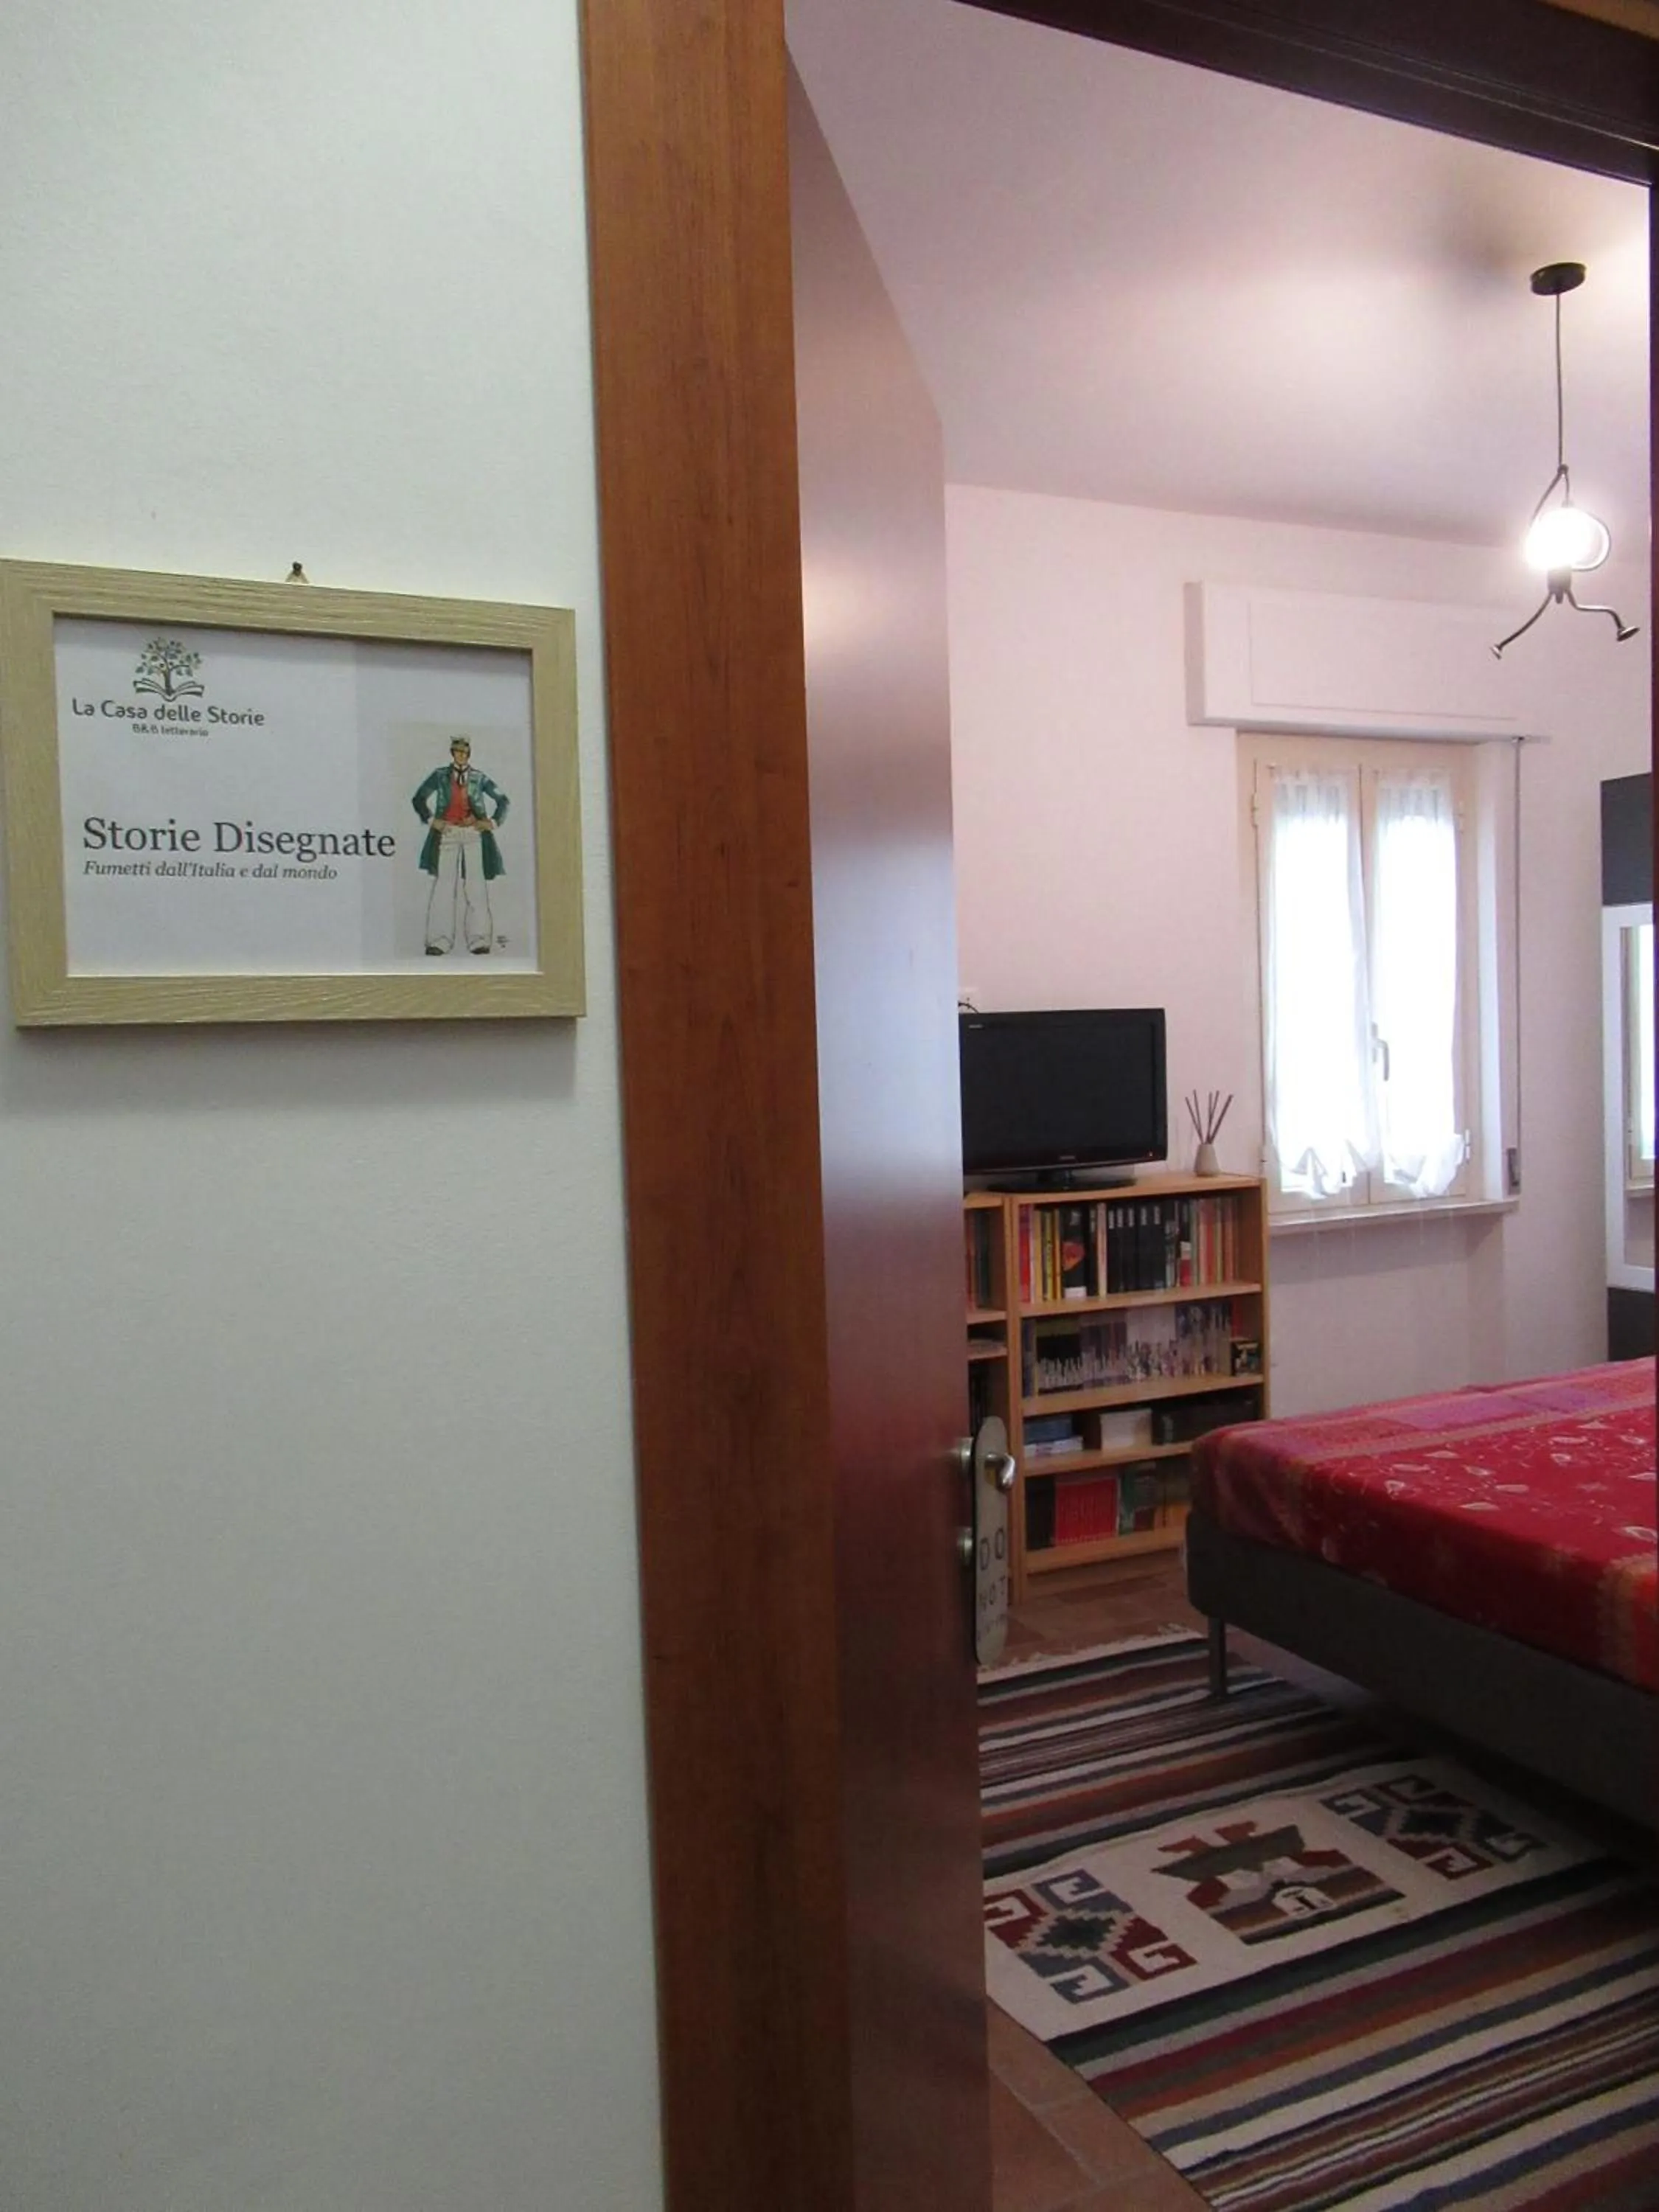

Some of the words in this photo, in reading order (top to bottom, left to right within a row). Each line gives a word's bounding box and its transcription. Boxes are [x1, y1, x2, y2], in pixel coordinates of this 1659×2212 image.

[72, 698, 95, 717] La
[101, 700, 147, 719] Casa
[153, 704, 201, 723] delle
[207, 706, 265, 726] Storie
[132, 723, 158, 735] B&B
[161, 725, 209, 737] letterario
[83, 817, 201, 852] Storie
[213, 821, 397, 864] Disegnate
[83, 860, 151, 877] Fumetti
[155, 862, 236, 879] dall'Italia
[240, 867, 249, 878] e
[252, 863, 277, 880] dal
[282, 863, 338, 881] mondo
